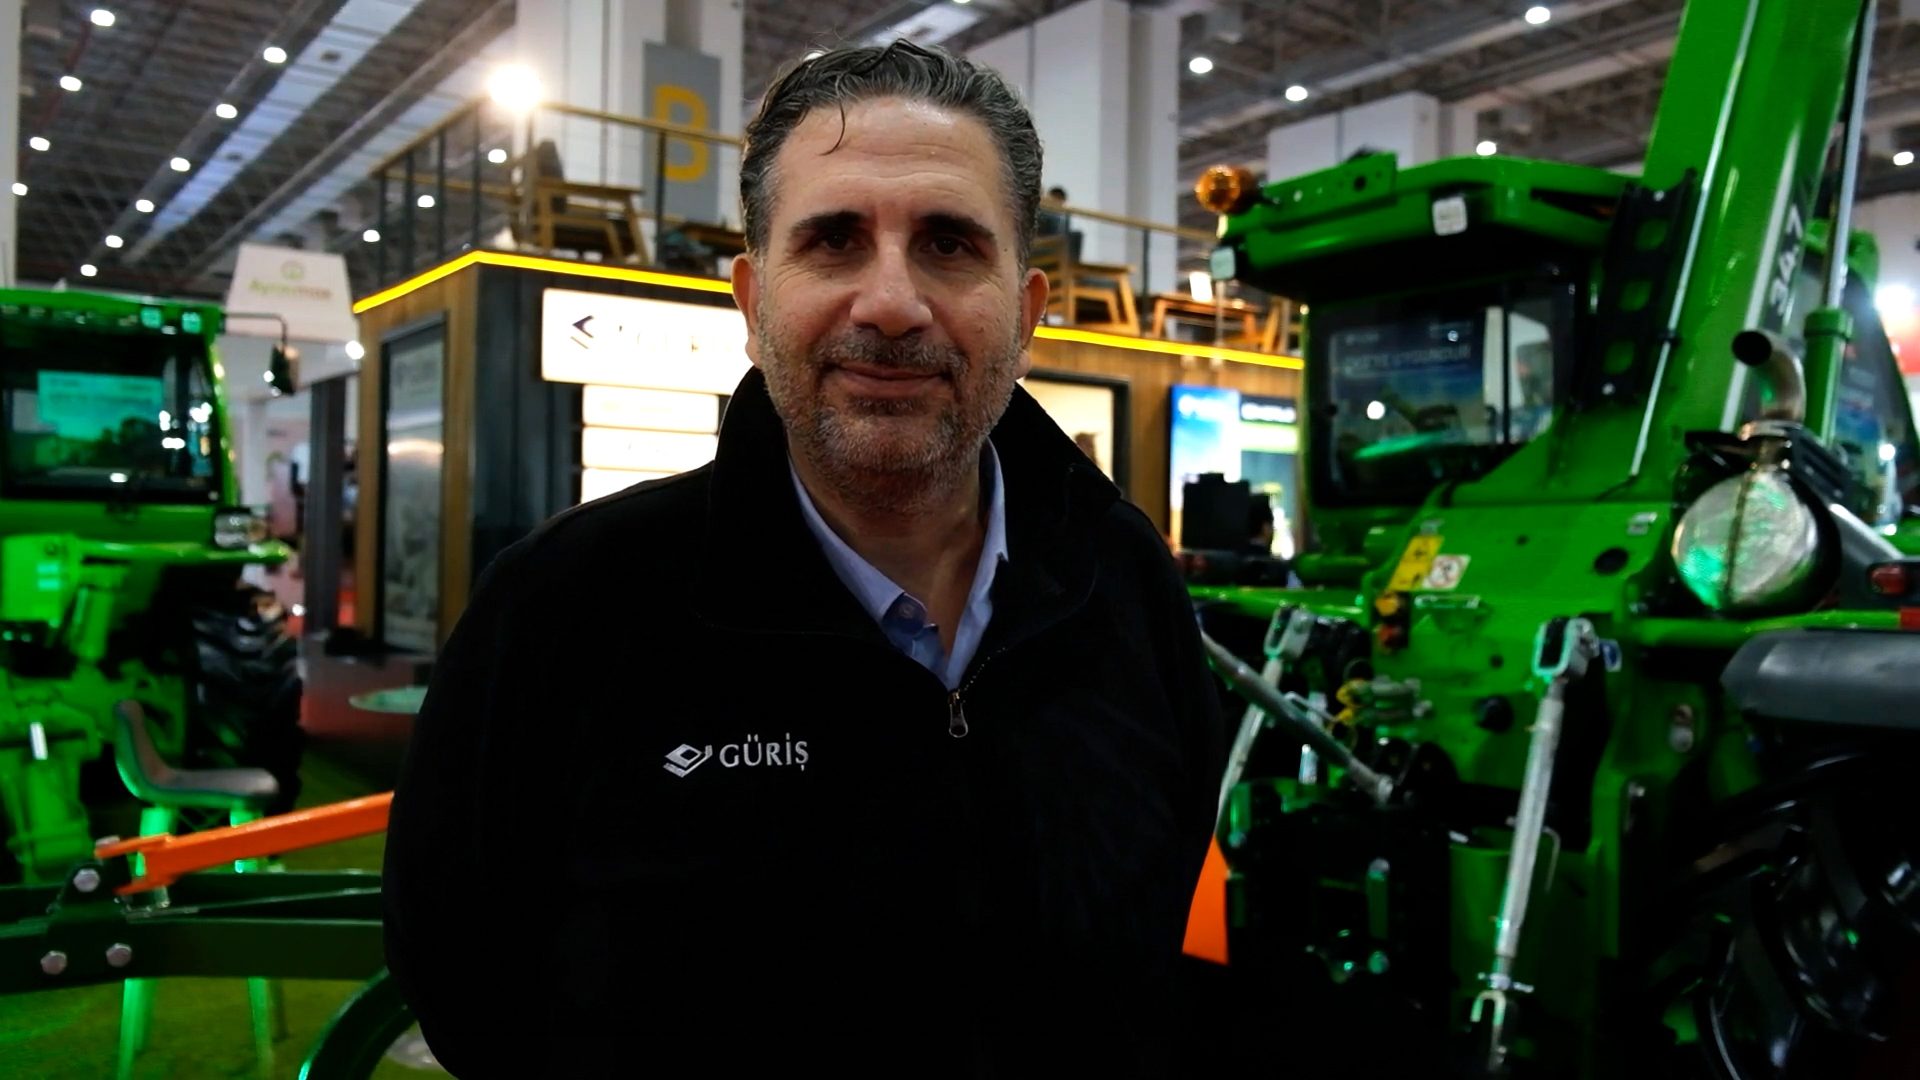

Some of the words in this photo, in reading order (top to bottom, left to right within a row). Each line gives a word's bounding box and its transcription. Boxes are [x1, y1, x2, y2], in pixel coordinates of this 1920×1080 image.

[653, 84, 709, 182] B
[1769, 204, 1803, 317] 34.7
[719, 732, 809, 771] GÜRİŞ
